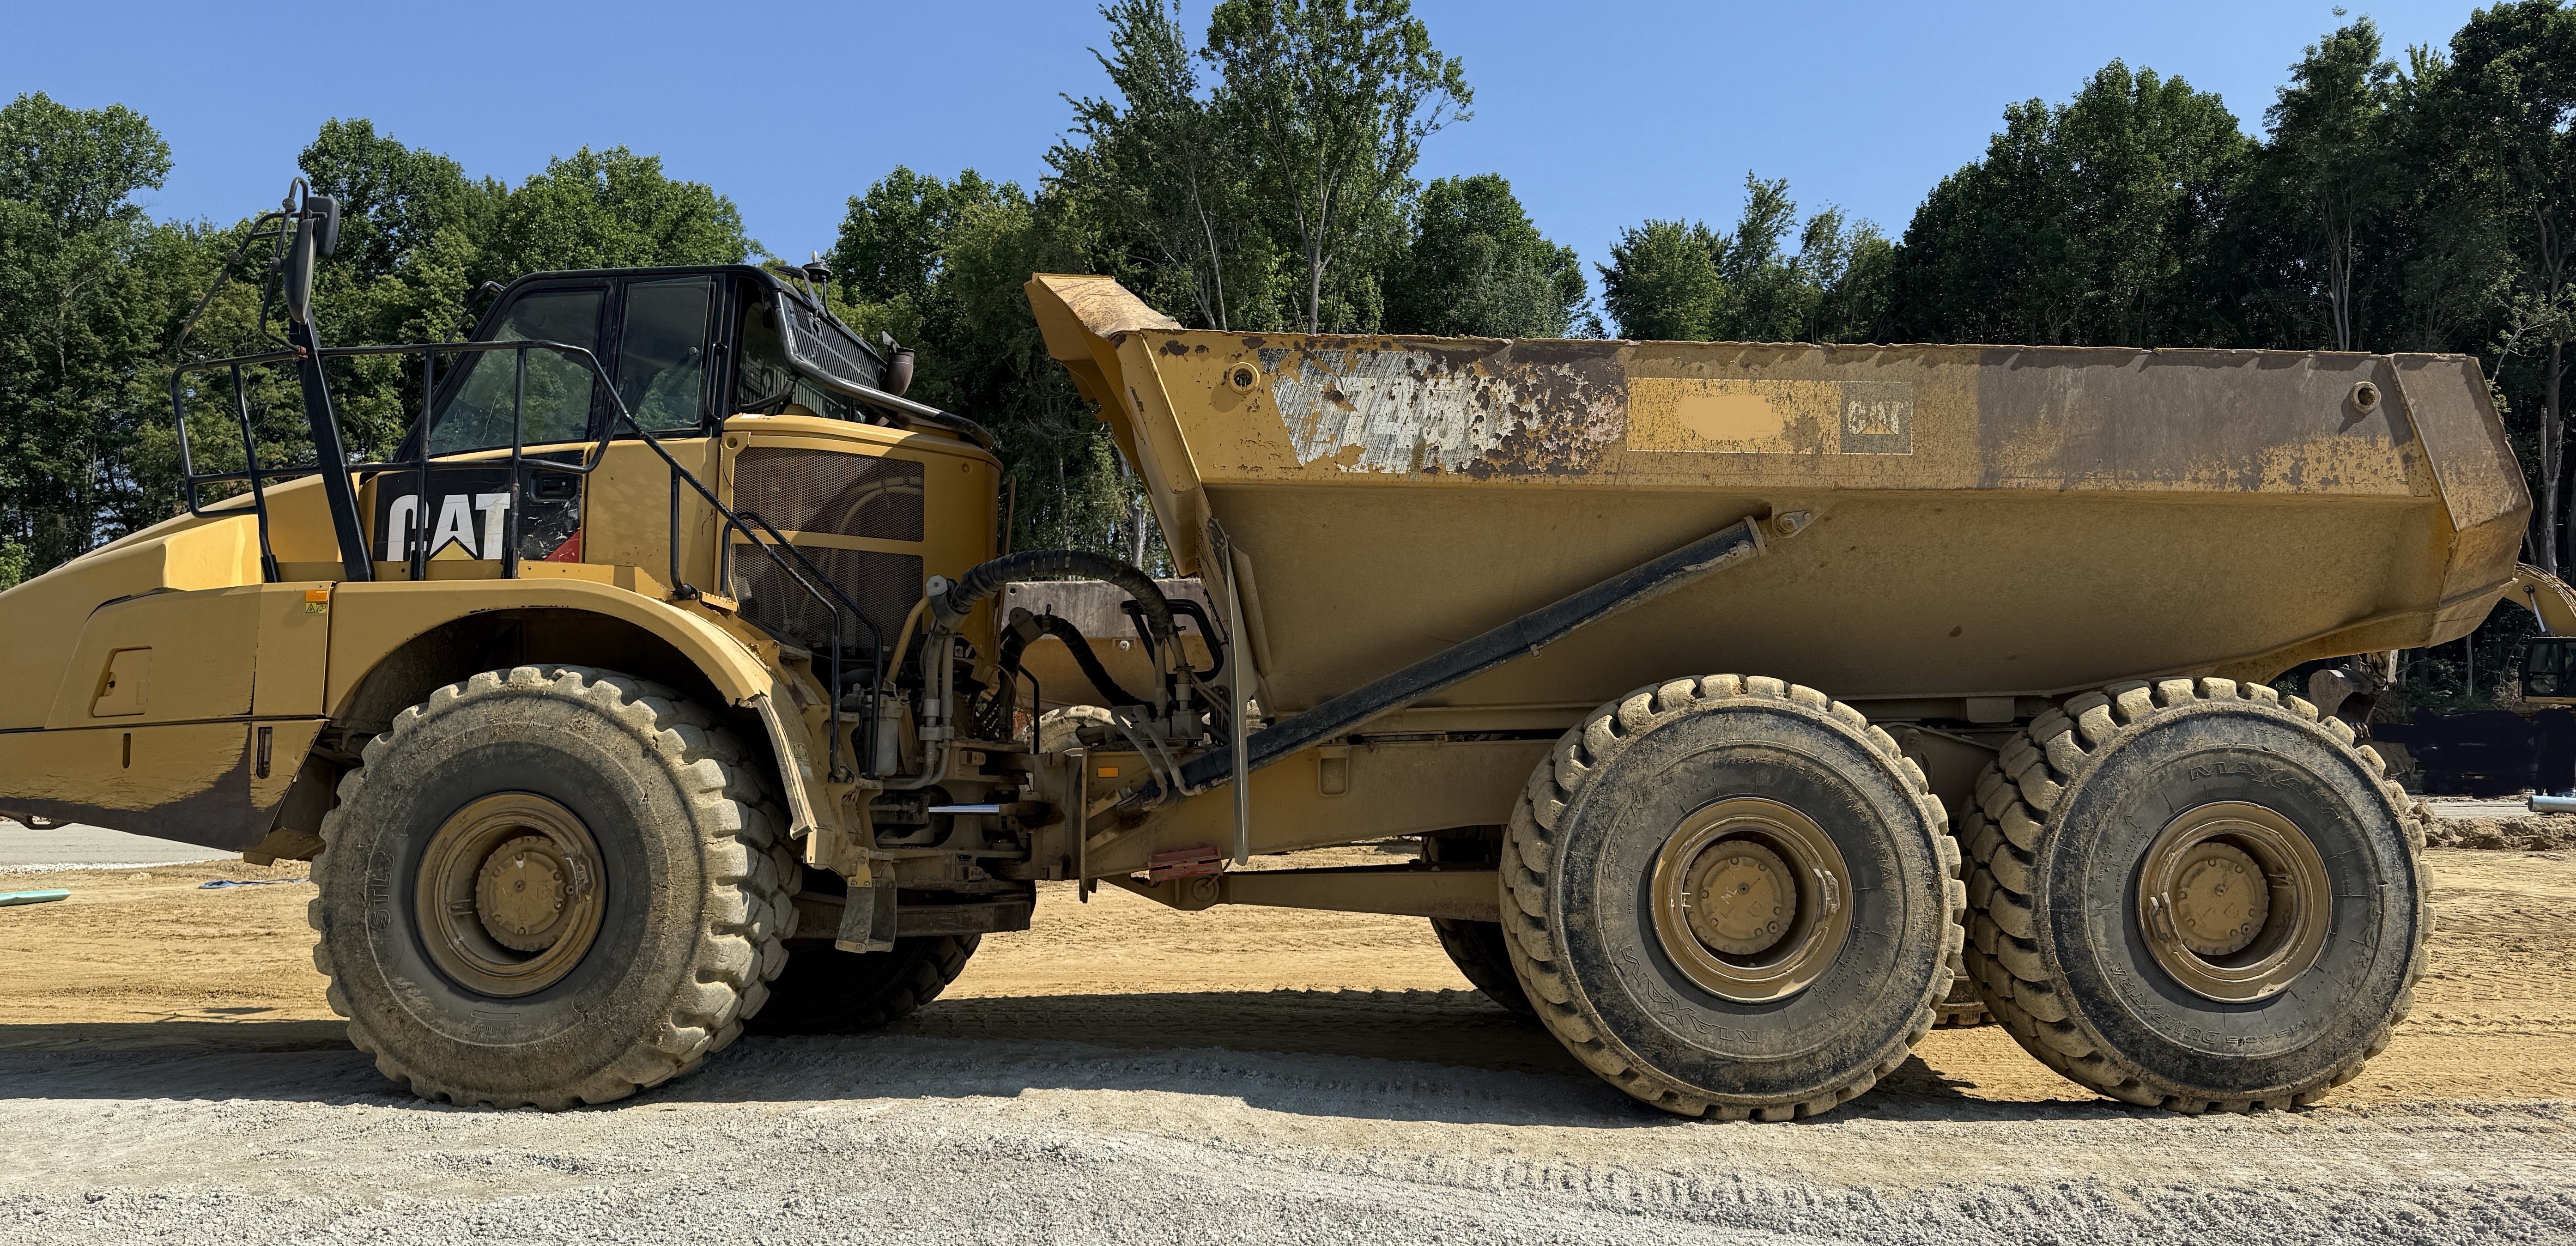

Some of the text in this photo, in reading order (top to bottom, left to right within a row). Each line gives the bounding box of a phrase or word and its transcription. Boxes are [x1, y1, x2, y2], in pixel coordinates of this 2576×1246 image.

[1848, 401, 1908, 434] CAT
[387, 493, 510, 561] CAT
[1806, 771, 1893, 879] DUMPTRA
[2190, 761, 2340, 824] MAXAM
[368, 851, 395, 929] STL3
[1621, 945, 1758, 1043] MAXAM
[2111, 961, 2220, 1044] DUMPXTRA
